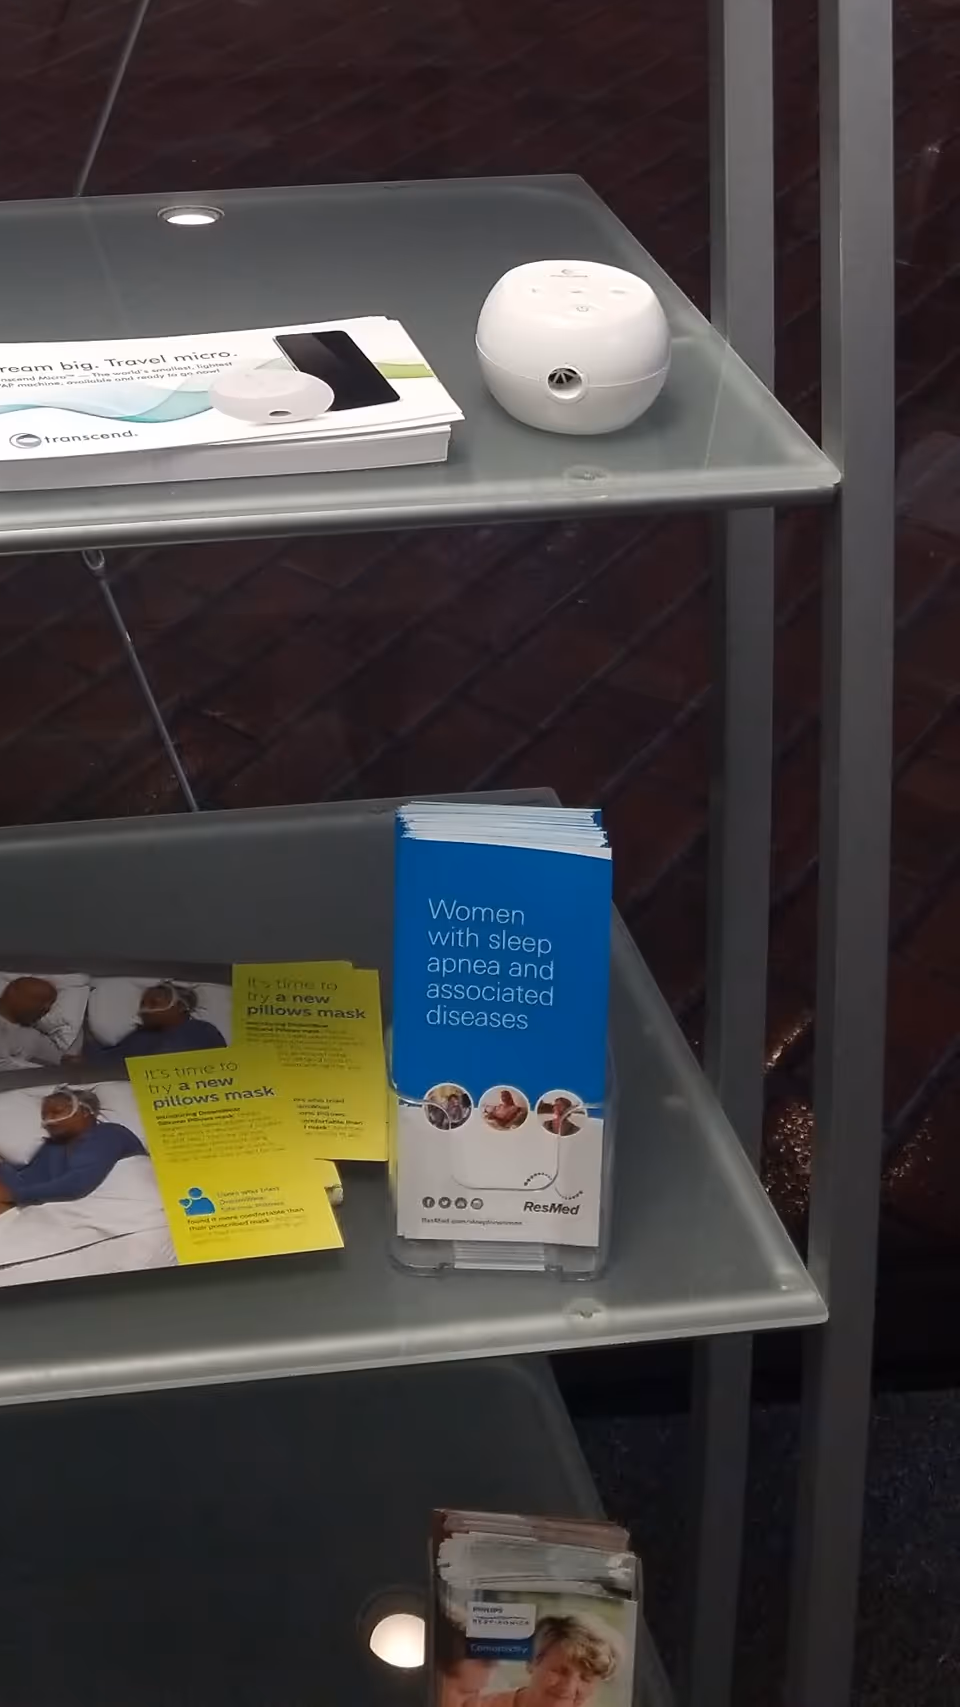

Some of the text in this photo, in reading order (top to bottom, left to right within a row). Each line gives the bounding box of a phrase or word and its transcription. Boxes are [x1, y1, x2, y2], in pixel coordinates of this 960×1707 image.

[59, 360, 100, 371] big.
[103, 354, 167, 367] Travel
[173, 351, 238, 362] micro.
[43, 430, 139, 444] transcend.
[428, 897, 525, 926] Women
[427, 926, 552, 958] with sleep
[426, 955, 555, 981] apnea and
[275, 979, 316, 991] time
[320, 981, 338, 991] to
[426, 981, 554, 1007] associated
[247, 991, 331, 1004] try a new
[246, 1004, 367, 1019] pillows mask
[425, 1004, 529, 1030] diseases
[144, 1060, 239, 1081] It's time to
[147, 1076, 234, 1095] try a new
[152, 1085, 276, 1111] pillows mask
[523, 1200, 581, 1216] ResMed
